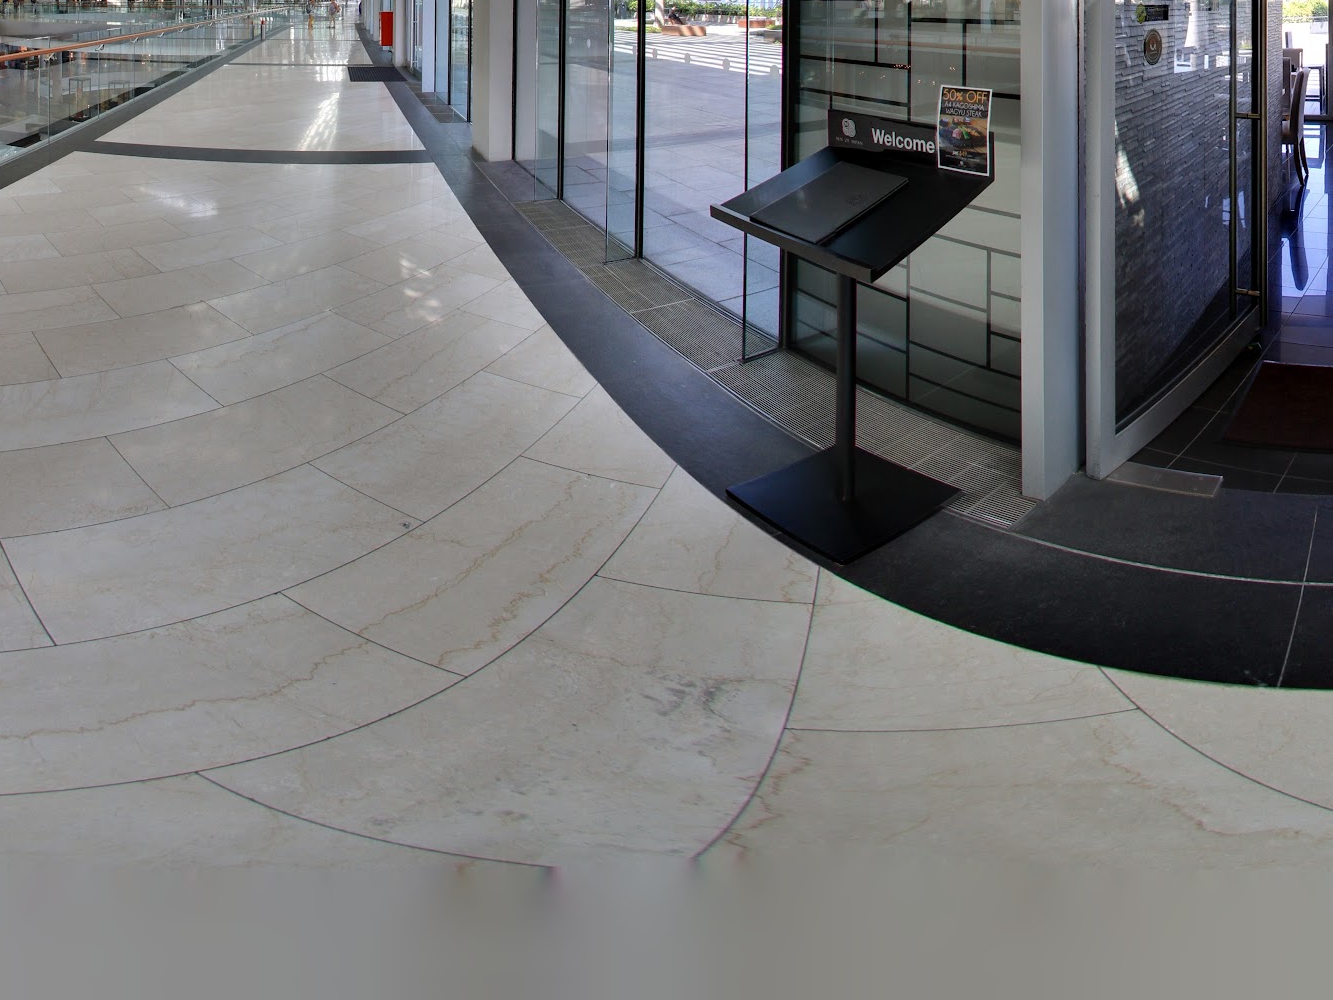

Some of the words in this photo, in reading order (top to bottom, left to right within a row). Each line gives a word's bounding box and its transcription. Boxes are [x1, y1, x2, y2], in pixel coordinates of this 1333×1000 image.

[943, 88, 963, 101] 50%
[966, 90, 988, 104] OFF
[946, 108, 965, 116] WAGYU
[966, 109, 983, 118] STEAK
[871, 127, 936, 154] Welcome
